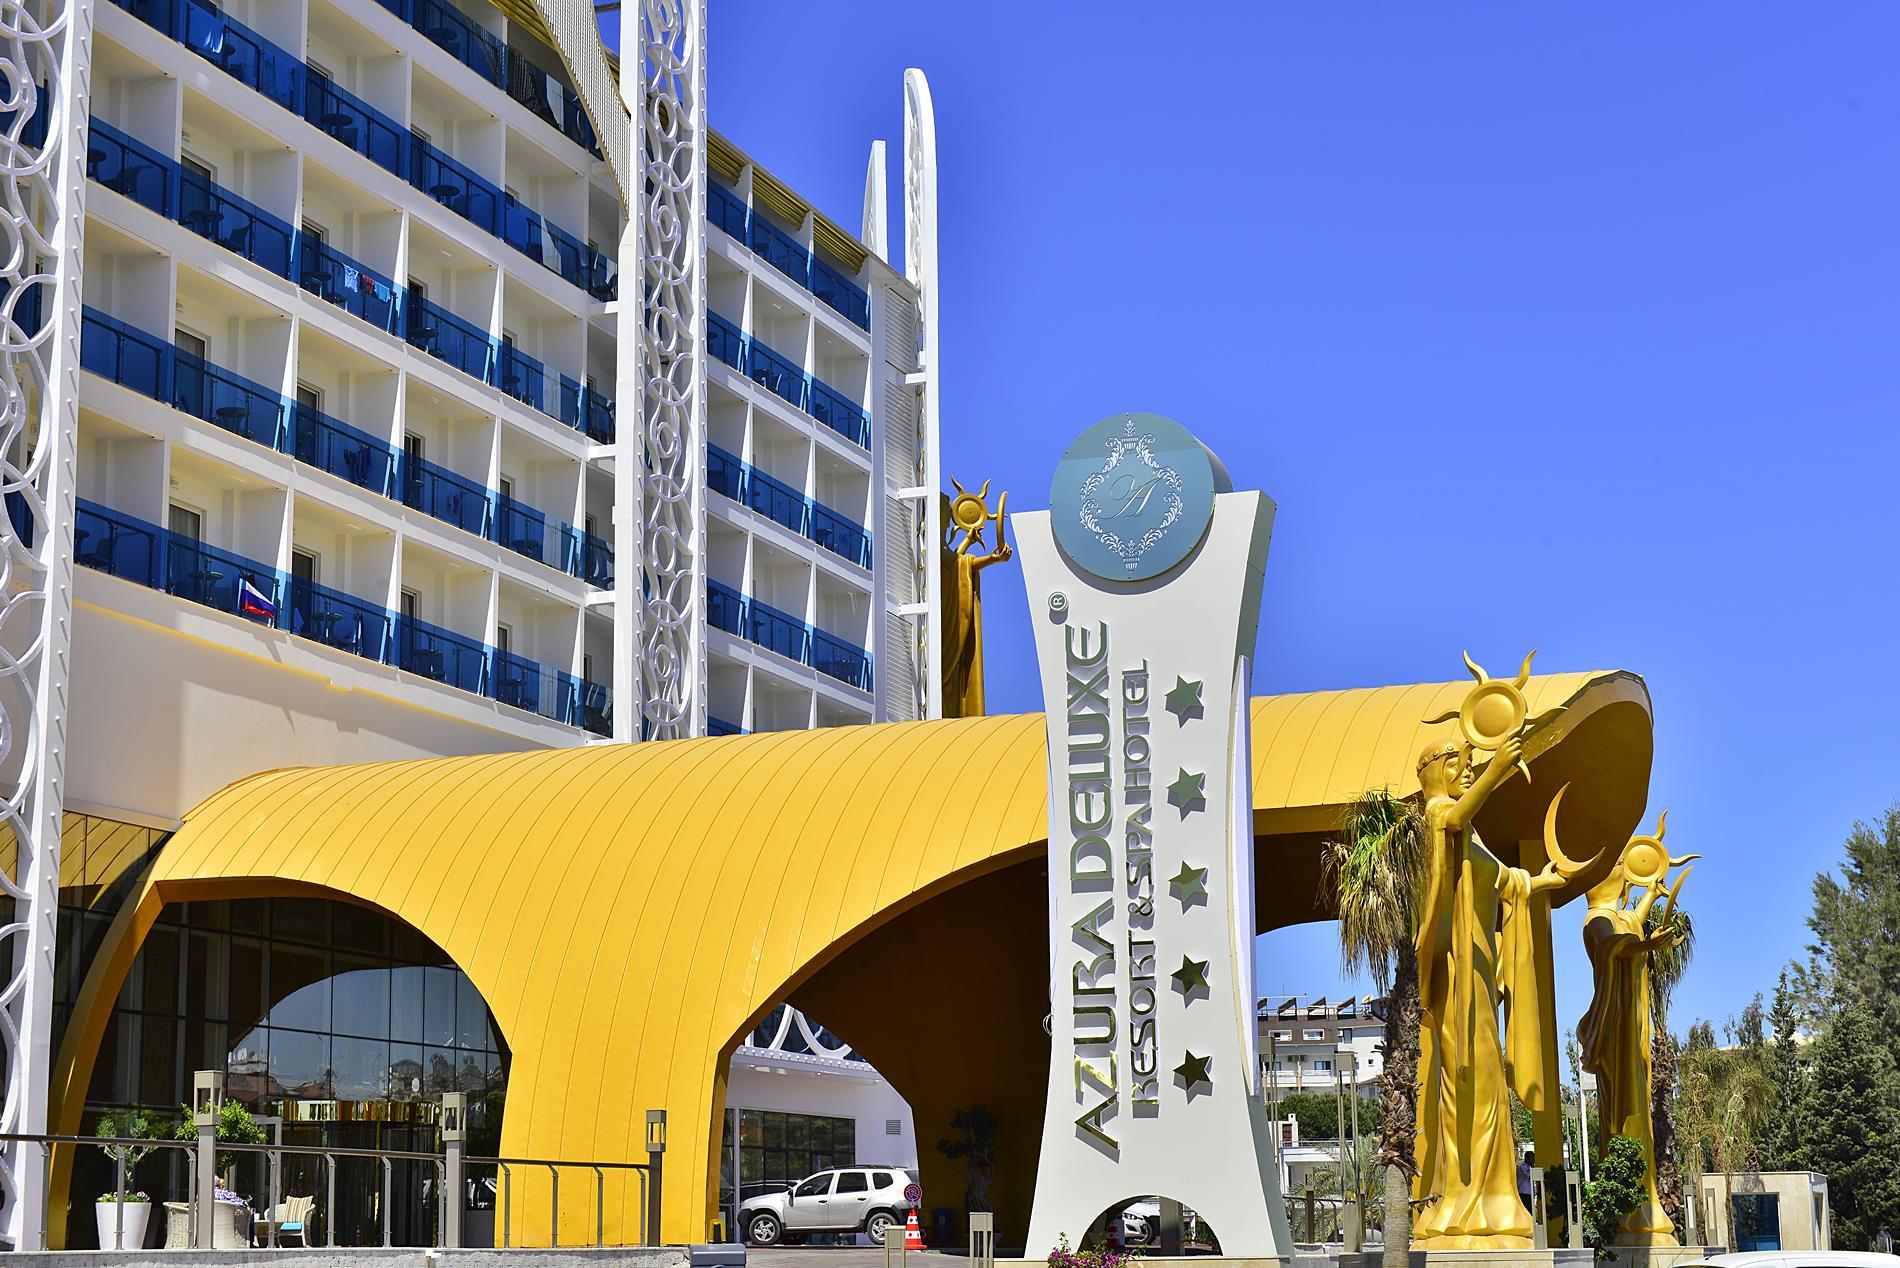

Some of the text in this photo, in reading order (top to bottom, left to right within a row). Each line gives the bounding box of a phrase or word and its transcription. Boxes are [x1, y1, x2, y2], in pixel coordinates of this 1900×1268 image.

[1065, 620, 1113, 884] DELUXE
[1121, 658, 1158, 1108] RESORT & SPA HOTEL
[1070, 896, 1120, 1155] AZURA
